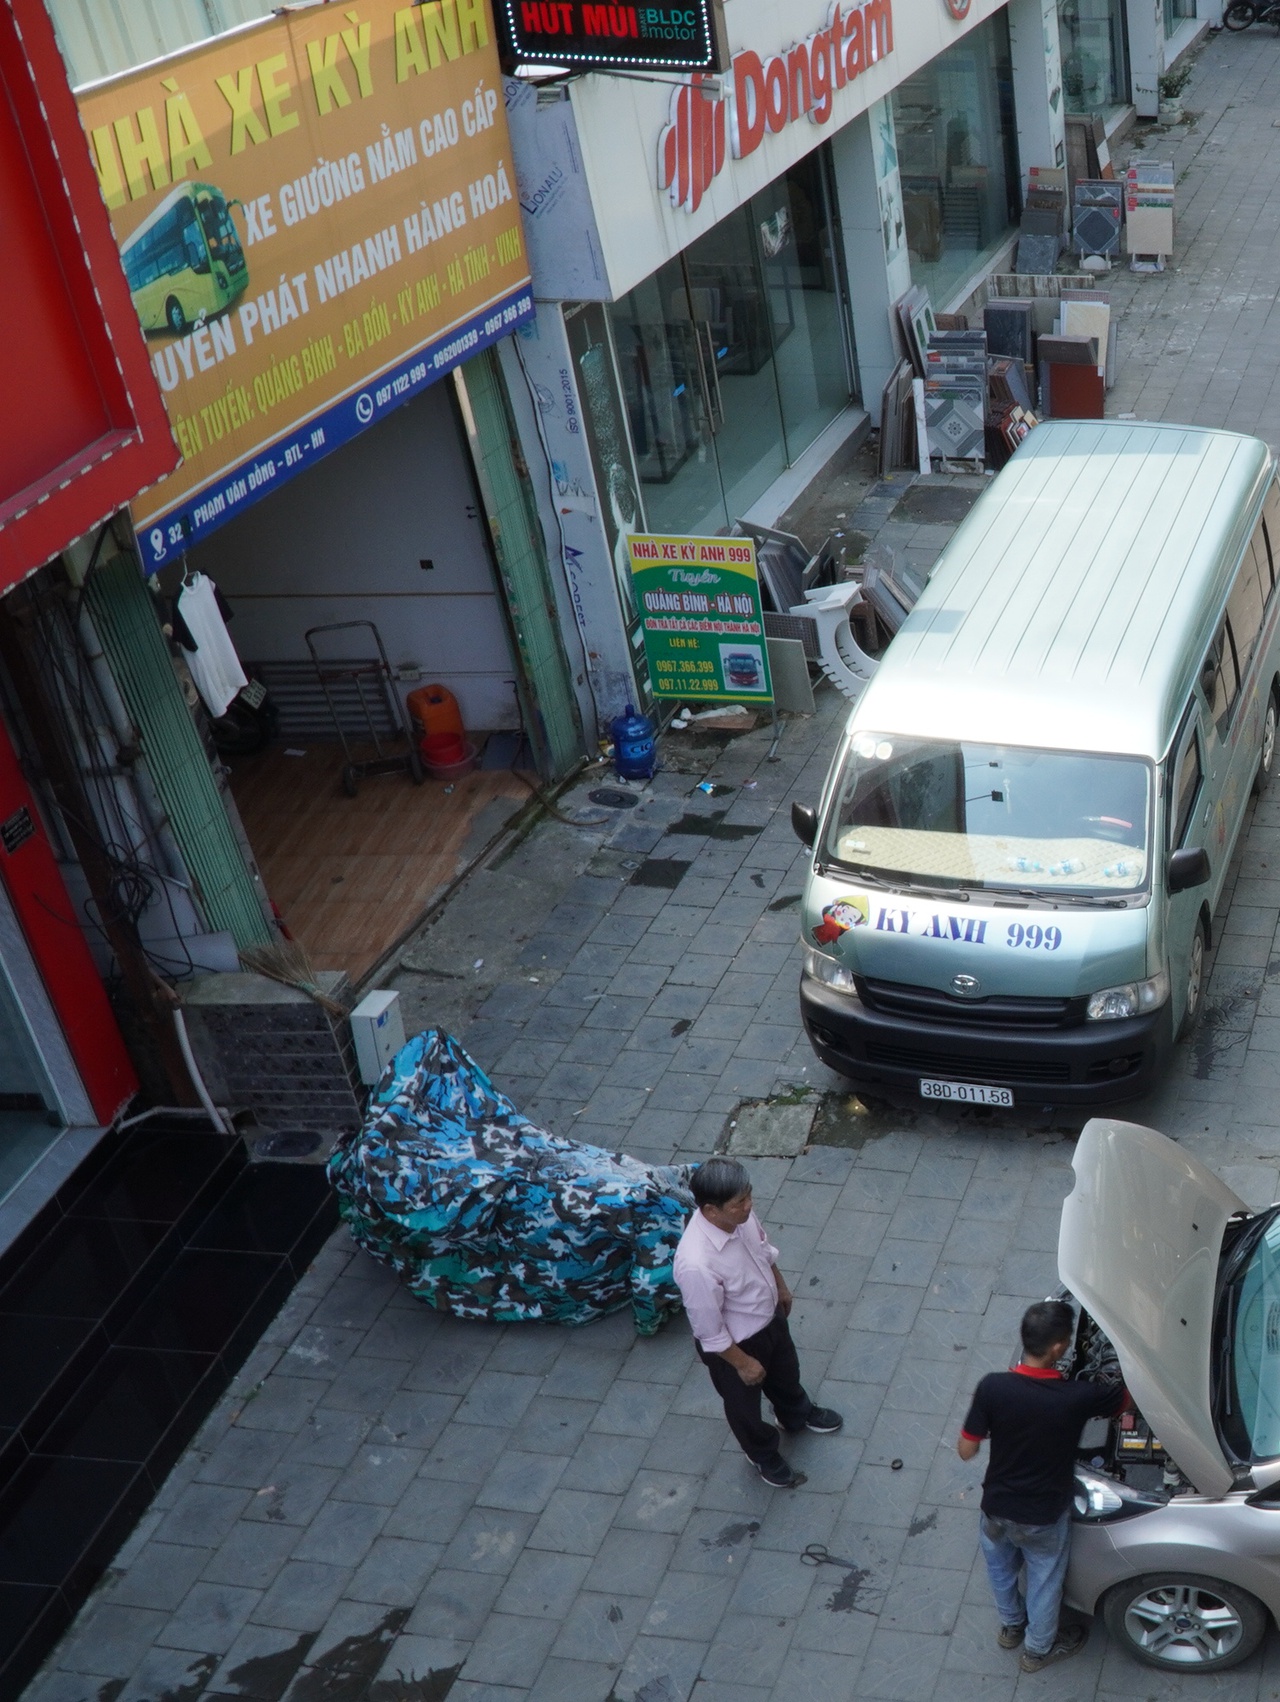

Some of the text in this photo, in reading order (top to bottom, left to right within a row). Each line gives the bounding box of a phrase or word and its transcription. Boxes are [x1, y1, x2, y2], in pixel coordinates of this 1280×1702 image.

[521, 0, 573, 35] HÚT
[647, 8, 696, 25] BLDC
[649, 25, 697, 40] motor
[215, 52, 299, 156] XE
[306, 10, 374, 116] KỲ
[394, 0, 489, 84] ANH
[244, 194, 277, 246] XE
[279, 152, 365, 226] GIƯỜNG
[366, 123, 417, 184] NẰM
[420, 108, 459, 157] CAO
[462, 79, 497, 137] CẤP
[239, 272, 309, 345] PHÁT
[314, 224, 401, 304] NHANH
[404, 191, 466, 254] HÀNG
[469, 160, 512, 219] HOÁ
[200, 379, 254, 445] TUYẾN:
[253, 353, 303, 415] QUẢNG
[302, 335, 337, 384] BÌNH
[343, 320, 364, 359] BA
[362, 296, 391, 347] ĐỒN
[398, 282, 414, 326] KỲ
[416, 273, 440, 316] ANH
[447, 253, 465, 296] HÀ
[496, 226, 521, 267] VINH
[376, 385, 391, 406] 097
[410, 362, 426, 384] 999
[518, 296, 532, 315] 399
[559, 368, 579, 434] ISO 9001:2015
[194, 494, 225, 527] PHẠM
[226, 479, 247, 505] VĂN
[248, 460, 276, 491] ĐỒNG
[285, 443, 303, 467] BTL
[311, 427, 325, 449] HN
[632, 540, 751, 562] NHÀ XE KỲ ANH 999
[644, 587, 680, 611] QUẢNG
[682, 591, 708, 612] BÌNH
[717, 592, 732, 612] HÀ
[734, 593, 753, 617] NỘI
[669, 637, 686, 648] LIÊN
[656, 660, 714, 672] 0967.366.399
[658, 678, 719, 691] 097.11.22.999
[922, 913, 989, 944] ANH
[1007, 923, 1062, 951] 999
[923, 1083, 1010, 1104] 38D-011.58
